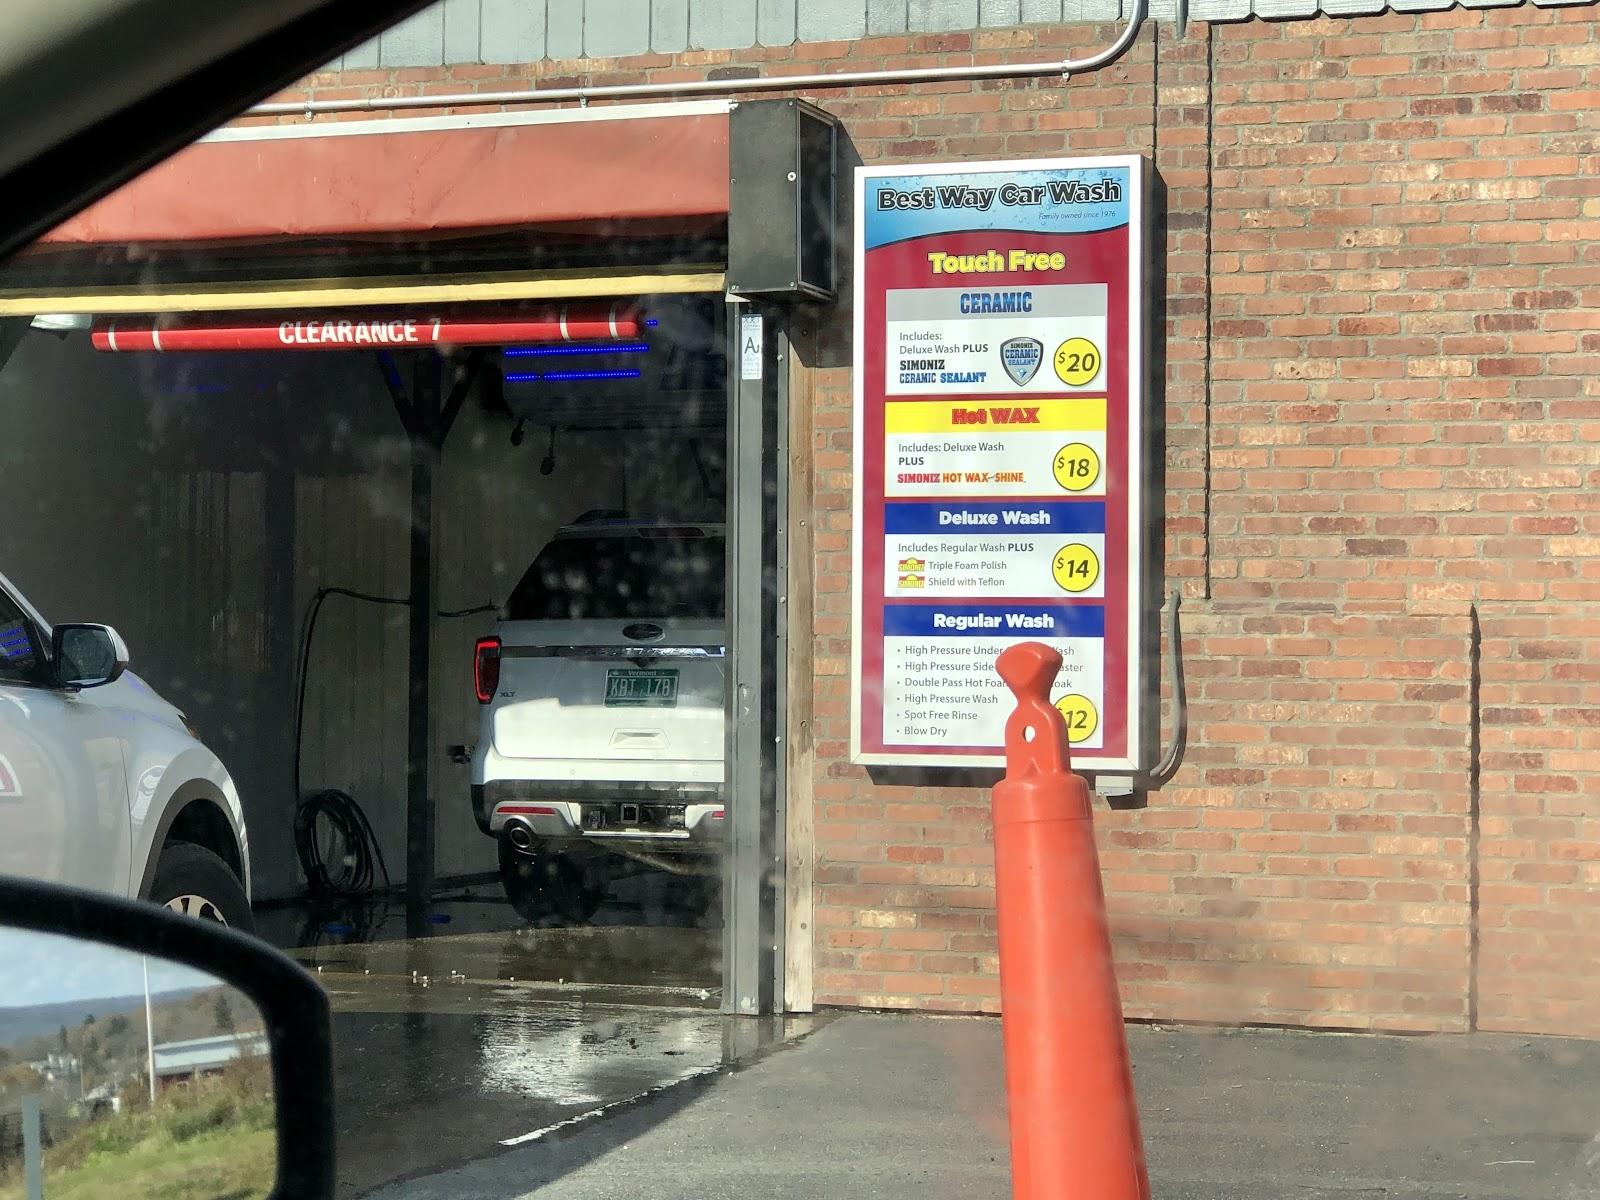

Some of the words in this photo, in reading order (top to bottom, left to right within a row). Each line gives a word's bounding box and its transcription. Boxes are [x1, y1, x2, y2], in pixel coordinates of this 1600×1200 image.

[877, 188, 935, 211] Best
[937, 185, 996, 211] Way
[999, 182, 1046, 206] Car
[1047, 179, 1121, 204] Wash
[928, 250, 1004, 274] Touch
[1009, 249, 1066, 271] Free
[960, 291, 1033, 314] CERAMIC
[279, 319, 418, 344] CLEARANCE
[899, 331, 942, 341] Includes:
[899, 345, 932, 354] Deluxe
[934, 345, 960, 354] Wash
[962, 343, 989, 353] PLUS
[1005, 349, 1039, 359] CERAMIC
[899, 359, 945, 371] SIMONIZ
[1058, 351, 1095, 372] $20
[899, 373, 937, 383] CERAMIC
[940, 372, 987, 383] SEALANT
[951, 408, 987, 425] Hot
[989, 407, 1040, 424] WAX
[898, 443, 941, 453] Includes:
[943, 443, 977, 452] Deluxe
[978, 442, 1004, 451] Wash
[898, 457, 924, 466] PLUS
[1057, 456, 1090, 477] $18
[897, 473, 940, 483] SIMONIZ
[942, 473, 962, 483] HOT
[939, 511, 998, 525] Deluxe
[1001, 510, 1051, 525] Wash
[898, 543, 938, 552] Includes
[940, 543, 978, 554] Regular
[979, 543, 1005, 552] Wash
[1008, 543, 1034, 552] PLUS
[928, 561, 952, 571] Triple
[955, 562, 979, 570] Foam
[980, 561, 1007, 570] Polish
[1056, 556, 1089, 578] $14
[928, 577, 958, 586] Shield
[960, 577, 981, 586] with
[983, 578, 1005, 586] Teflon
[934, 613, 1001, 630] Regular
[1005, 613, 1055, 628] Wash
[905, 645, 928, 656] High
[931, 645, 971, 655] Pressure
[973, 645, 1003, 655] Under
[905, 661, 928, 672] High
[931, 662, 970, 671] Pressure
[610, 679, 636, 697] KBT
[645, 679, 670, 697] 178
[905, 677, 939, 687] Double
[942, 678, 962, 687] Pass
[965, 678, 983, 687] Hot
[1054, 679, 1072, 688] oak
[905, 693, 927, 704] High
[930, 694, 970, 704] Pressure
[972, 694, 998, 704] Wash
[904, 710, 927, 720] Spot
[929, 710, 950, 719] Free
[952, 711, 978, 720] Rinse
[904, 726, 928, 735] Blow
[930, 727, 948, 737] Dry
